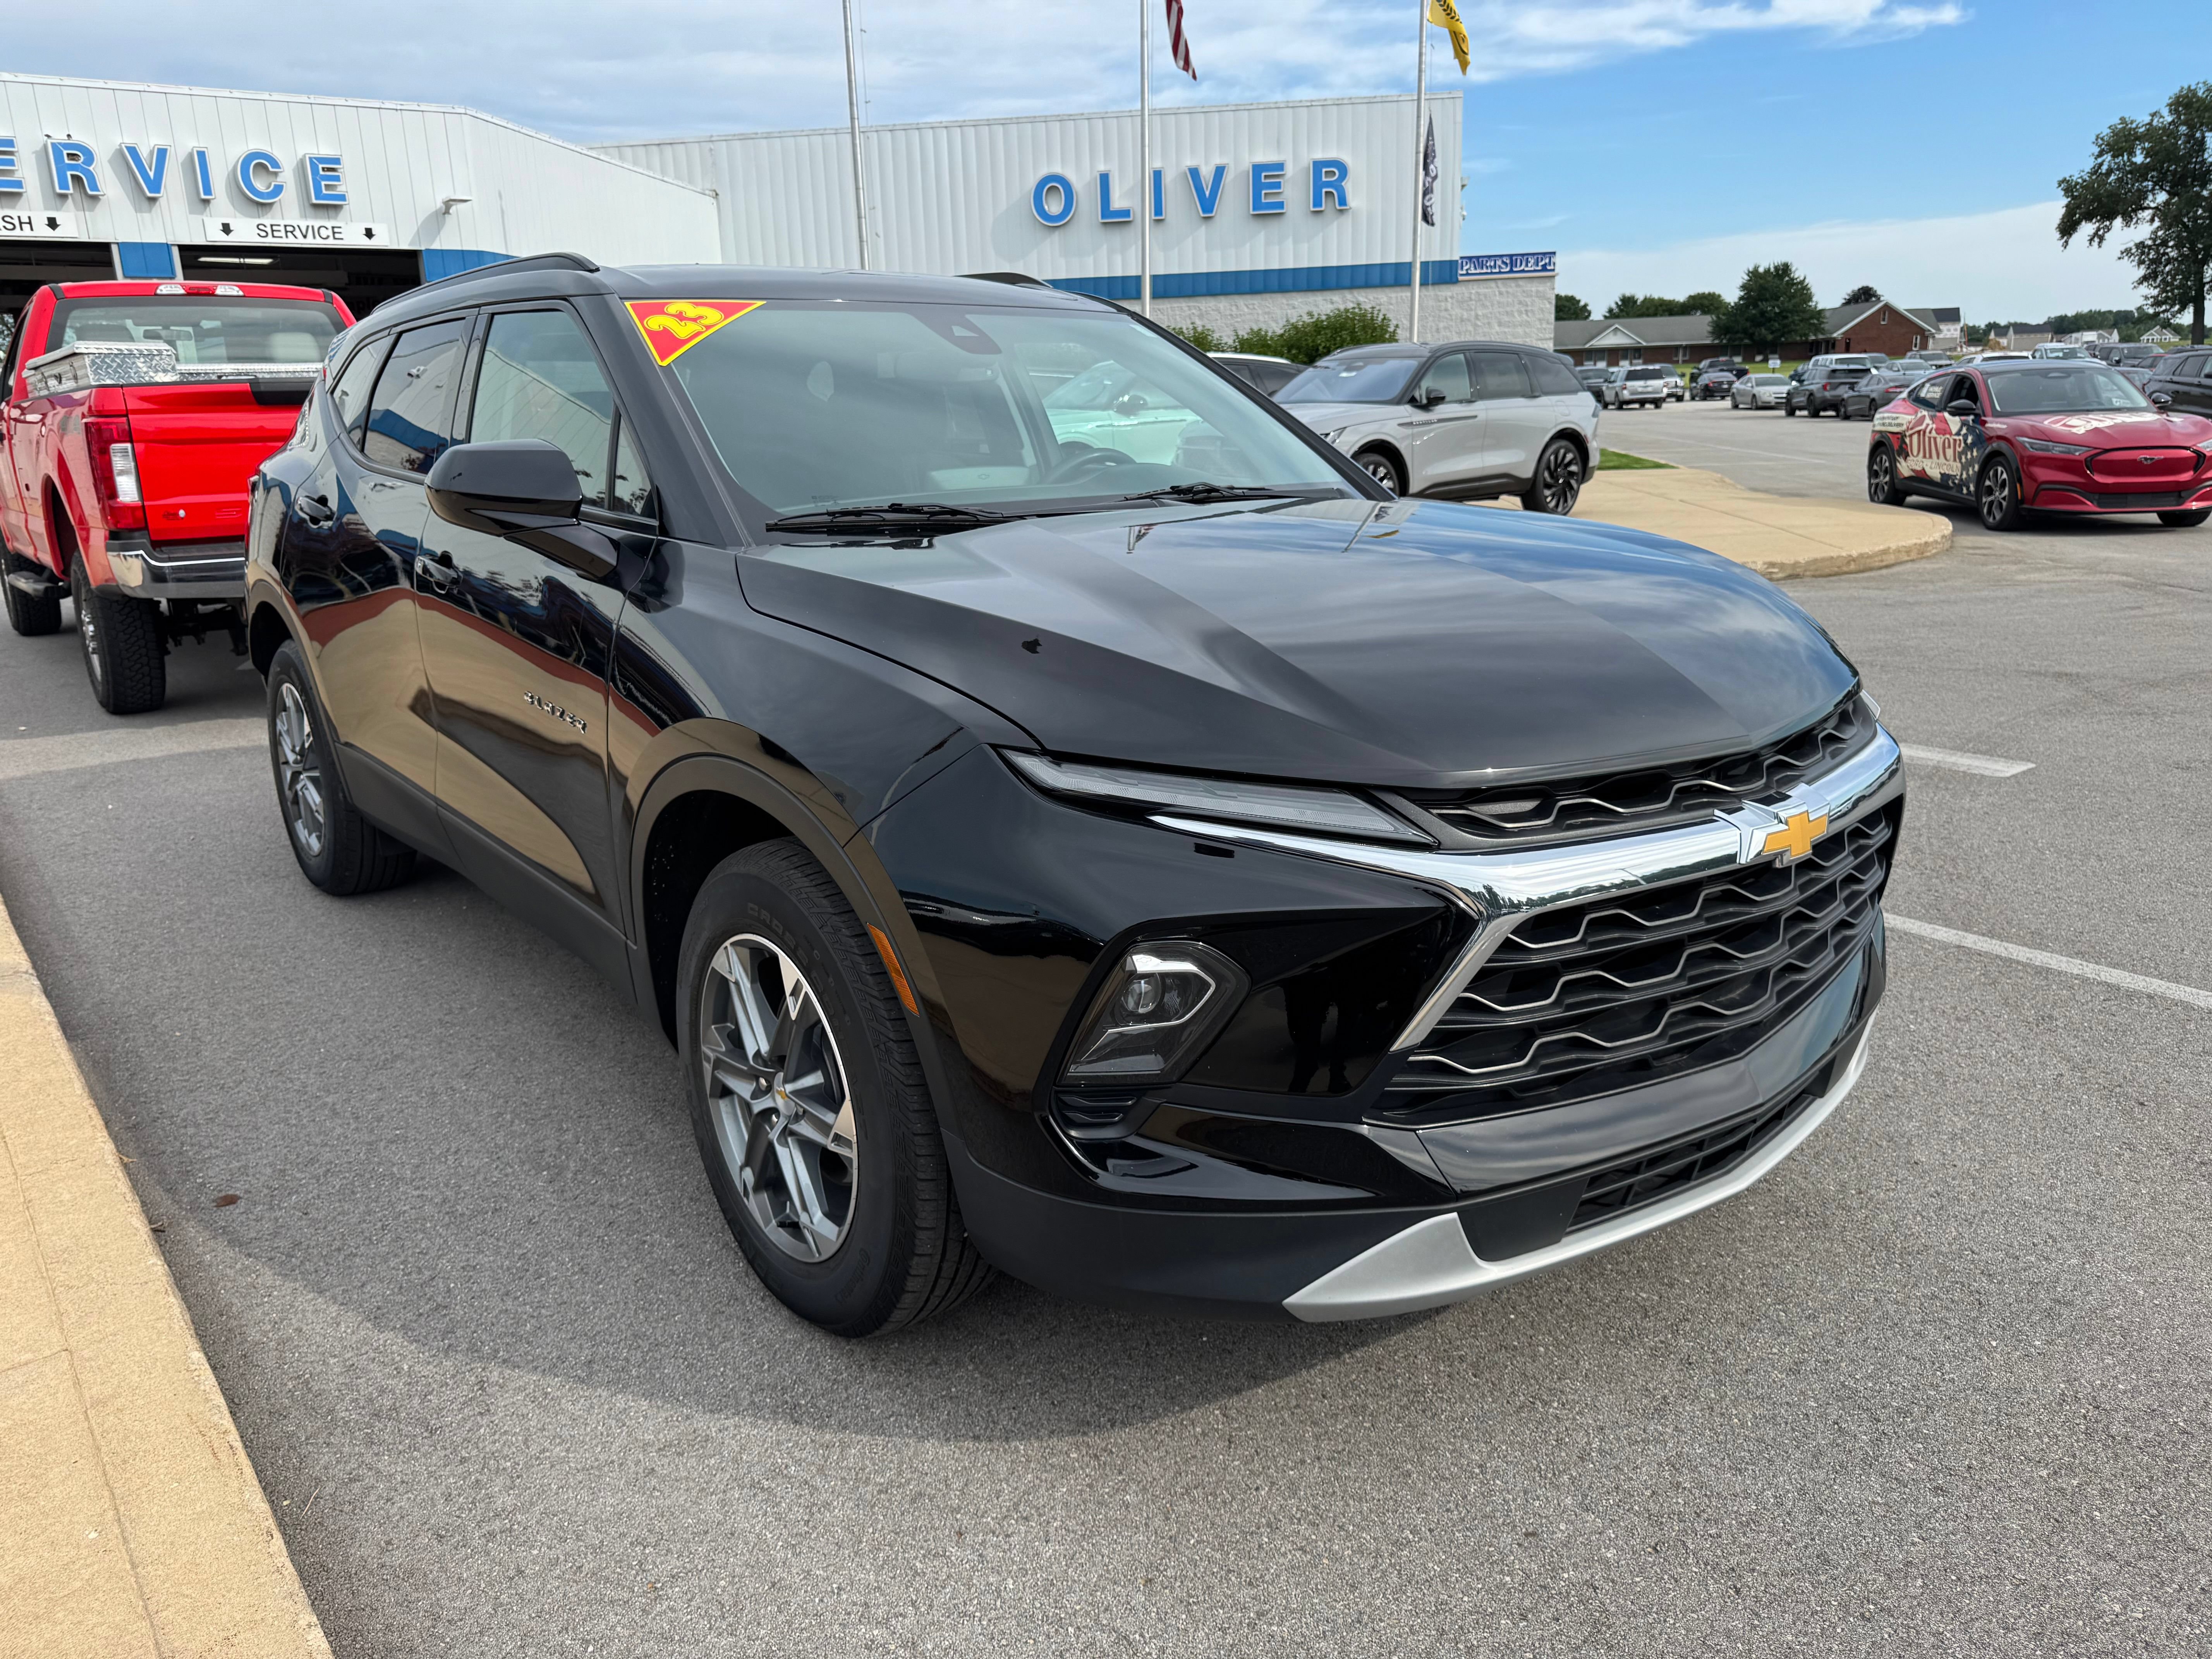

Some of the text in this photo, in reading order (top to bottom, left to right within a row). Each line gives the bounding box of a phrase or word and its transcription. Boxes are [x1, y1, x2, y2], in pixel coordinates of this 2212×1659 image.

[1030, 158, 1352, 227] OLIVER
[0, 215, 34, 232] SH
[256, 223, 344, 240] SERVICE
[1458, 254, 1555, 274] PARTS DEPT
[644, 302, 725, 339] 23
[1908, 414, 1962, 463] Oliver
[1906, 460, 1961, 473] FORD LINCOLN
[524, 690, 587, 734] BLAZER
